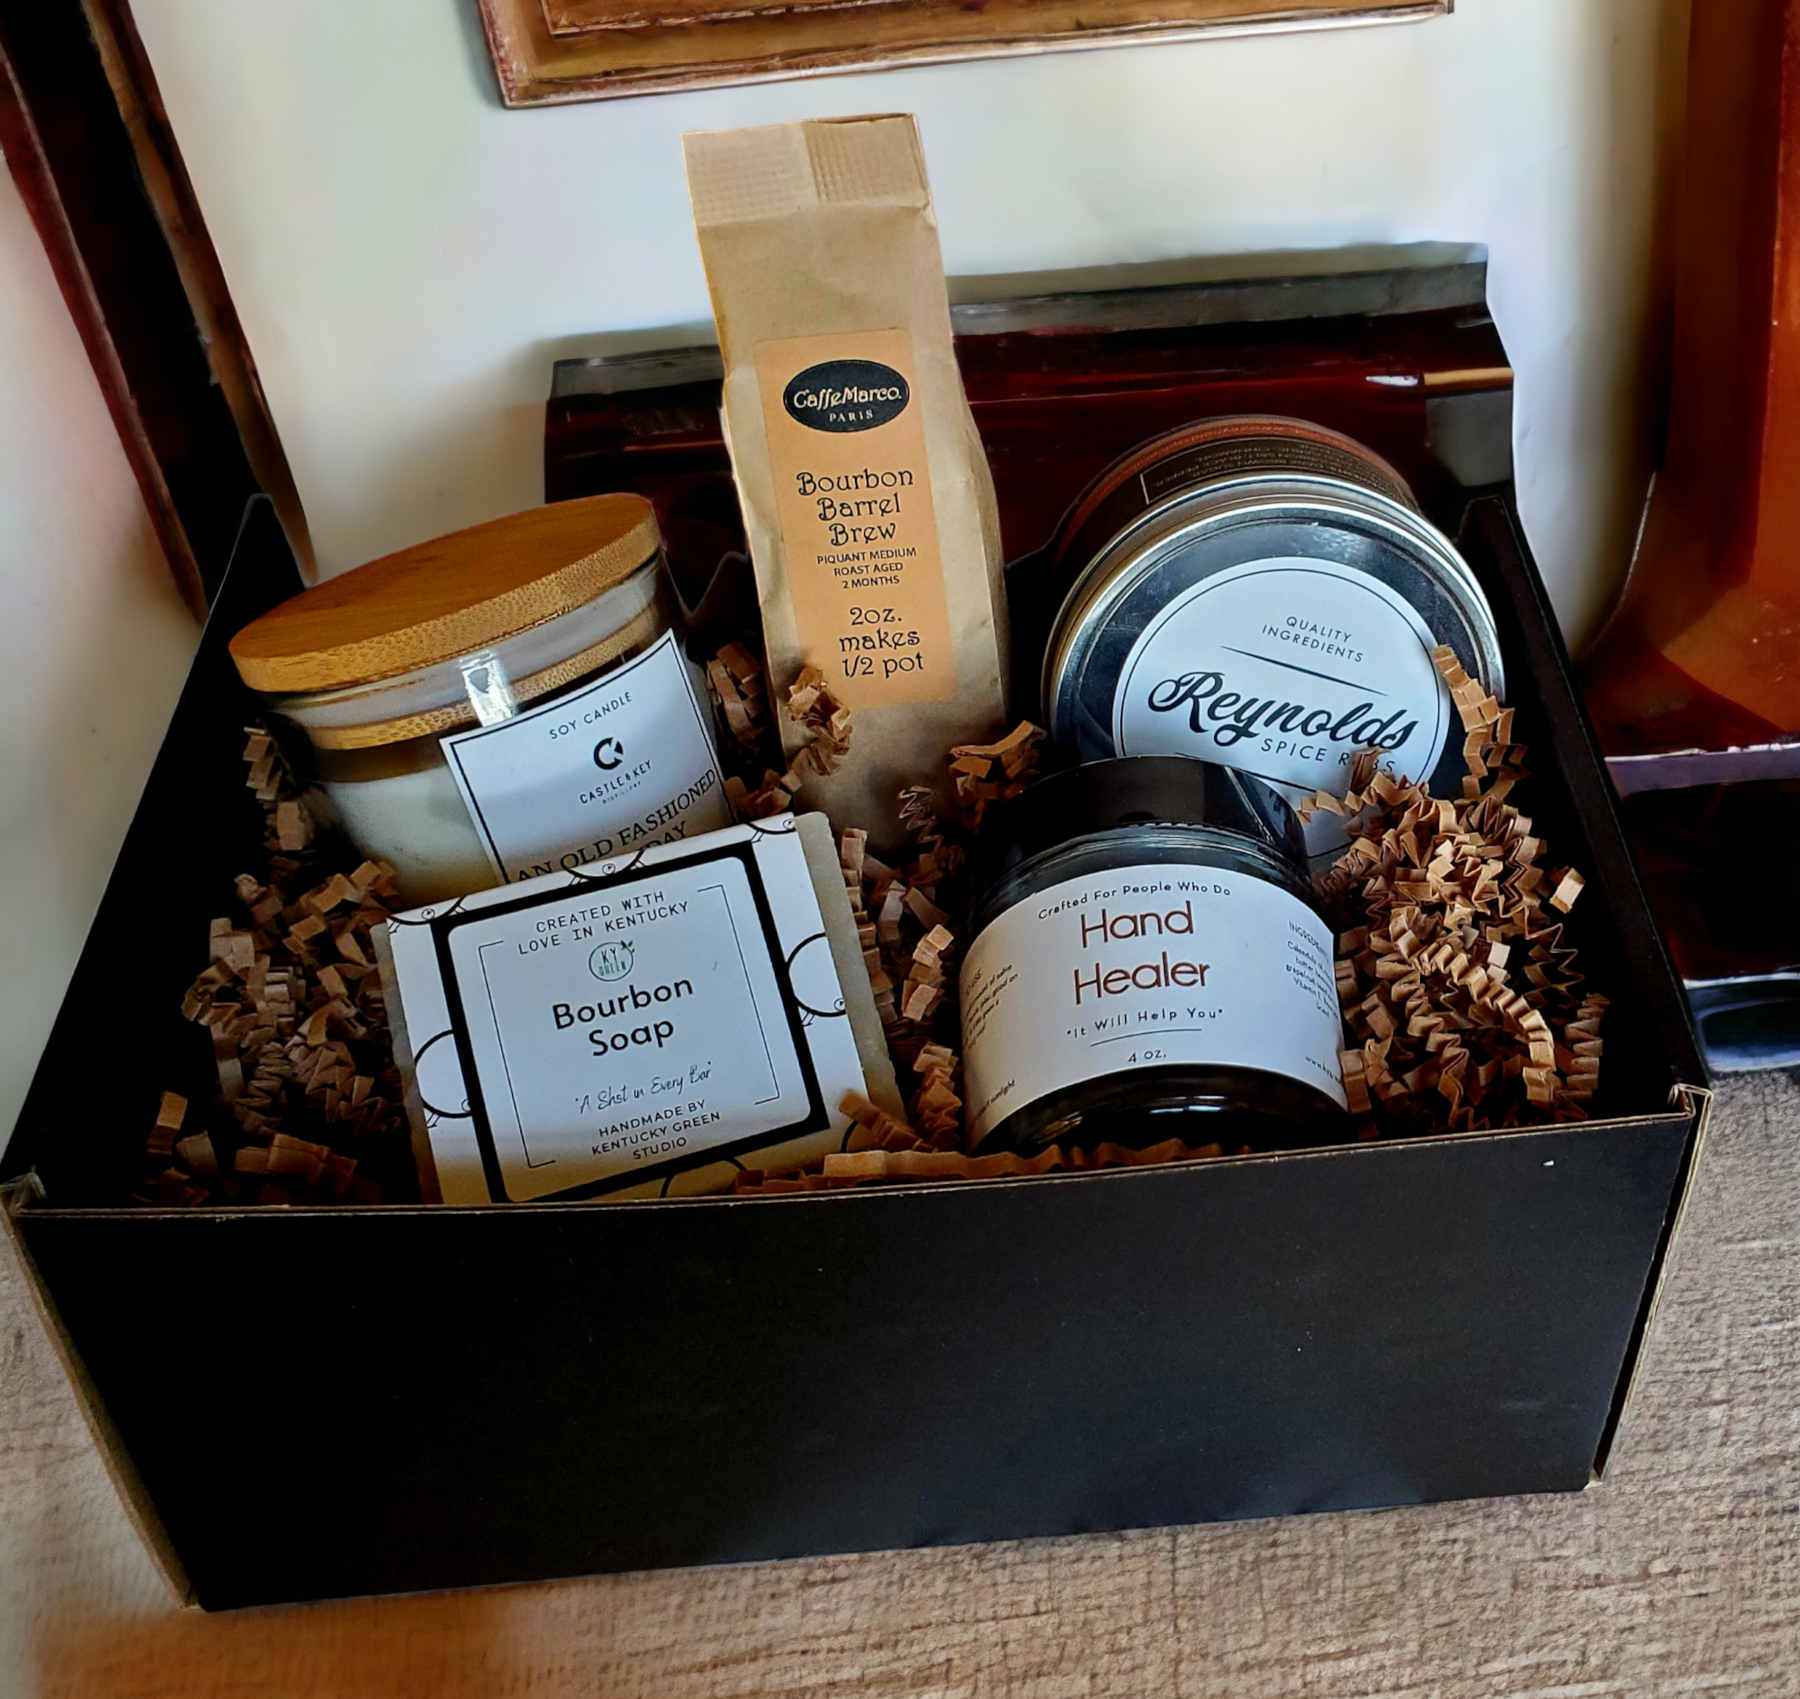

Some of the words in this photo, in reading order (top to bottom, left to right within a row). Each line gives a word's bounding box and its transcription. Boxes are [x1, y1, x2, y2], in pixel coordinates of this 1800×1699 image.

[829, 409, 874, 422] PARIS
[796, 468, 913, 496] Bourbon
[817, 492, 901, 521] Barrel
[829, 523, 896, 546] Brew
[817, 552, 866, 564] PIQUANT
[870, 547, 917, 560] MEDIUM
[834, 565, 870, 576] ROAST
[873, 562, 903, 573] AGED
[842, 580, 849, 589] 2
[851, 575, 900, 588] MONTHS
[850, 607, 903, 626] 2oz.
[1286, 616, 1352, 643] QUALITY
[839, 628, 920, 652] makes
[1262, 624, 1364, 663] INGREDIENTS
[842, 655, 874, 678] 1/2
[883, 652, 924, 679] pot
[549, 719, 578, 740] SOY
[583, 691, 633, 726] CANDLE
[1148, 671, 1419, 750] Reynolds
[1261, 738, 1327, 762] SPICE
[580, 776, 624, 804] CASTLE
[633, 759, 651, 778] KEY
[518, 861, 551, 881] AN
[560, 839, 613, 871] OLD
[617, 768, 717, 847] FASHIONED
[536, 905, 611, 933] CREATED
[622, 890, 665, 911] WITH
[1038, 893, 1088, 920] Crafted
[1093, 888, 1117, 902] For
[1123, 881, 1171, 896] People
[1177, 881, 1208, 893] Who
[1213, 884, 1231, 896] Do
[518, 934, 561, 955] LOVE
[573, 926, 594, 942] IN
[605, 901, 690, 933] KENTUCKY
[1080, 900, 1194, 949] Hand
[1073, 951, 1211, 1005] Healer
[552, 978, 694, 1030] Bourbon
[1094, 1013, 1128, 1031] Will
[1138, 1008, 1178, 1022] Help
[588, 1020, 675, 1057] Soap
[1127, 1052, 1138, 1063] 4
[651, 1076, 684, 1096] Every
[599, 1105, 684, 1138] HANDMADE
[688, 1099, 706, 1113] BY
[591, 1127, 668, 1156] KENTUCKY
[672, 1111, 721, 1132] GREEN
[632, 1137, 687, 1160] STUDIO
